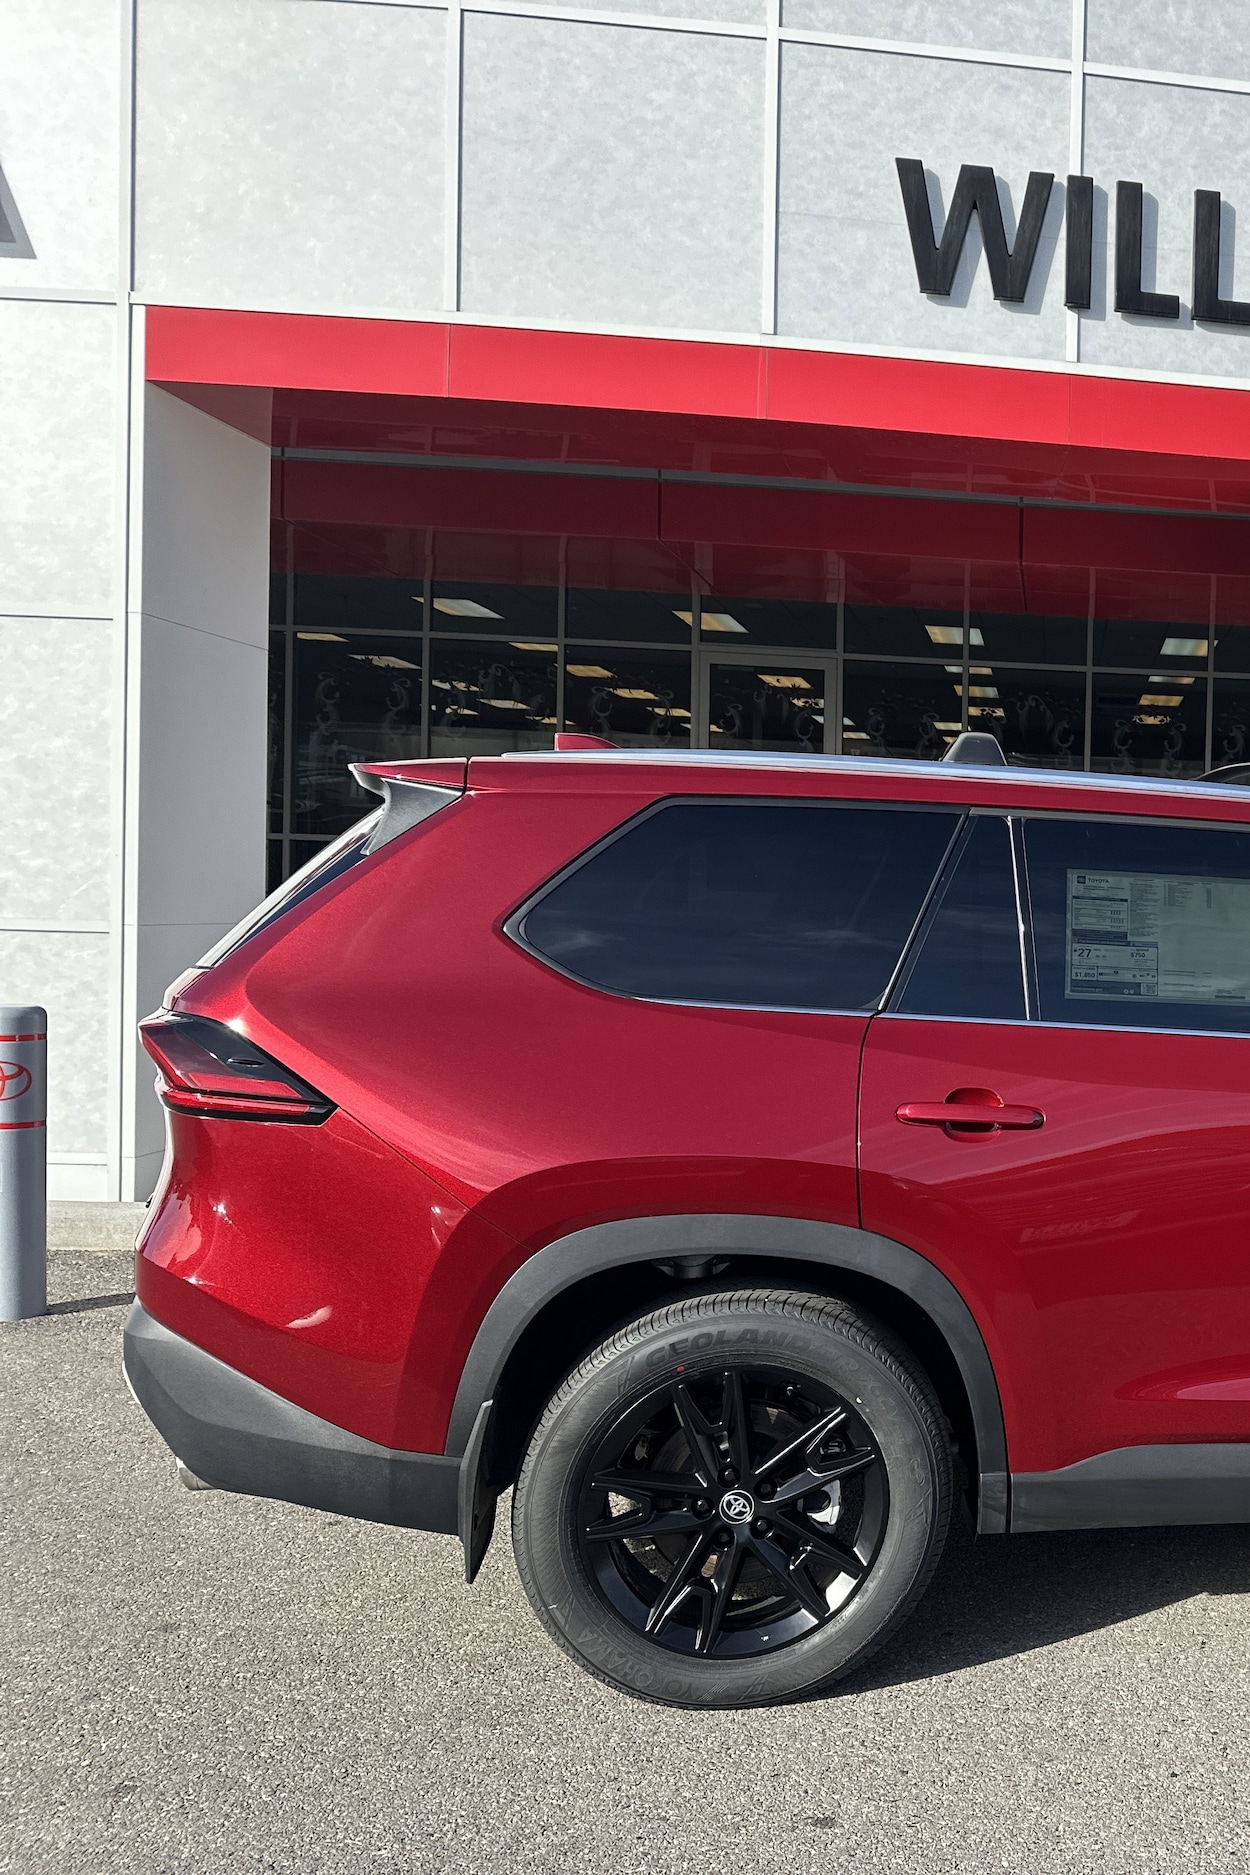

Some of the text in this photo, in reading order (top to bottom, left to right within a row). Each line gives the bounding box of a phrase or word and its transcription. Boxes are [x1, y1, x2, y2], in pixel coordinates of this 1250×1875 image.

[1077, 948, 1092, 958] 27
[645, 1328, 858, 1374] GEOLANDAR
[577, 1629, 698, 1699] YOKOHAMA
